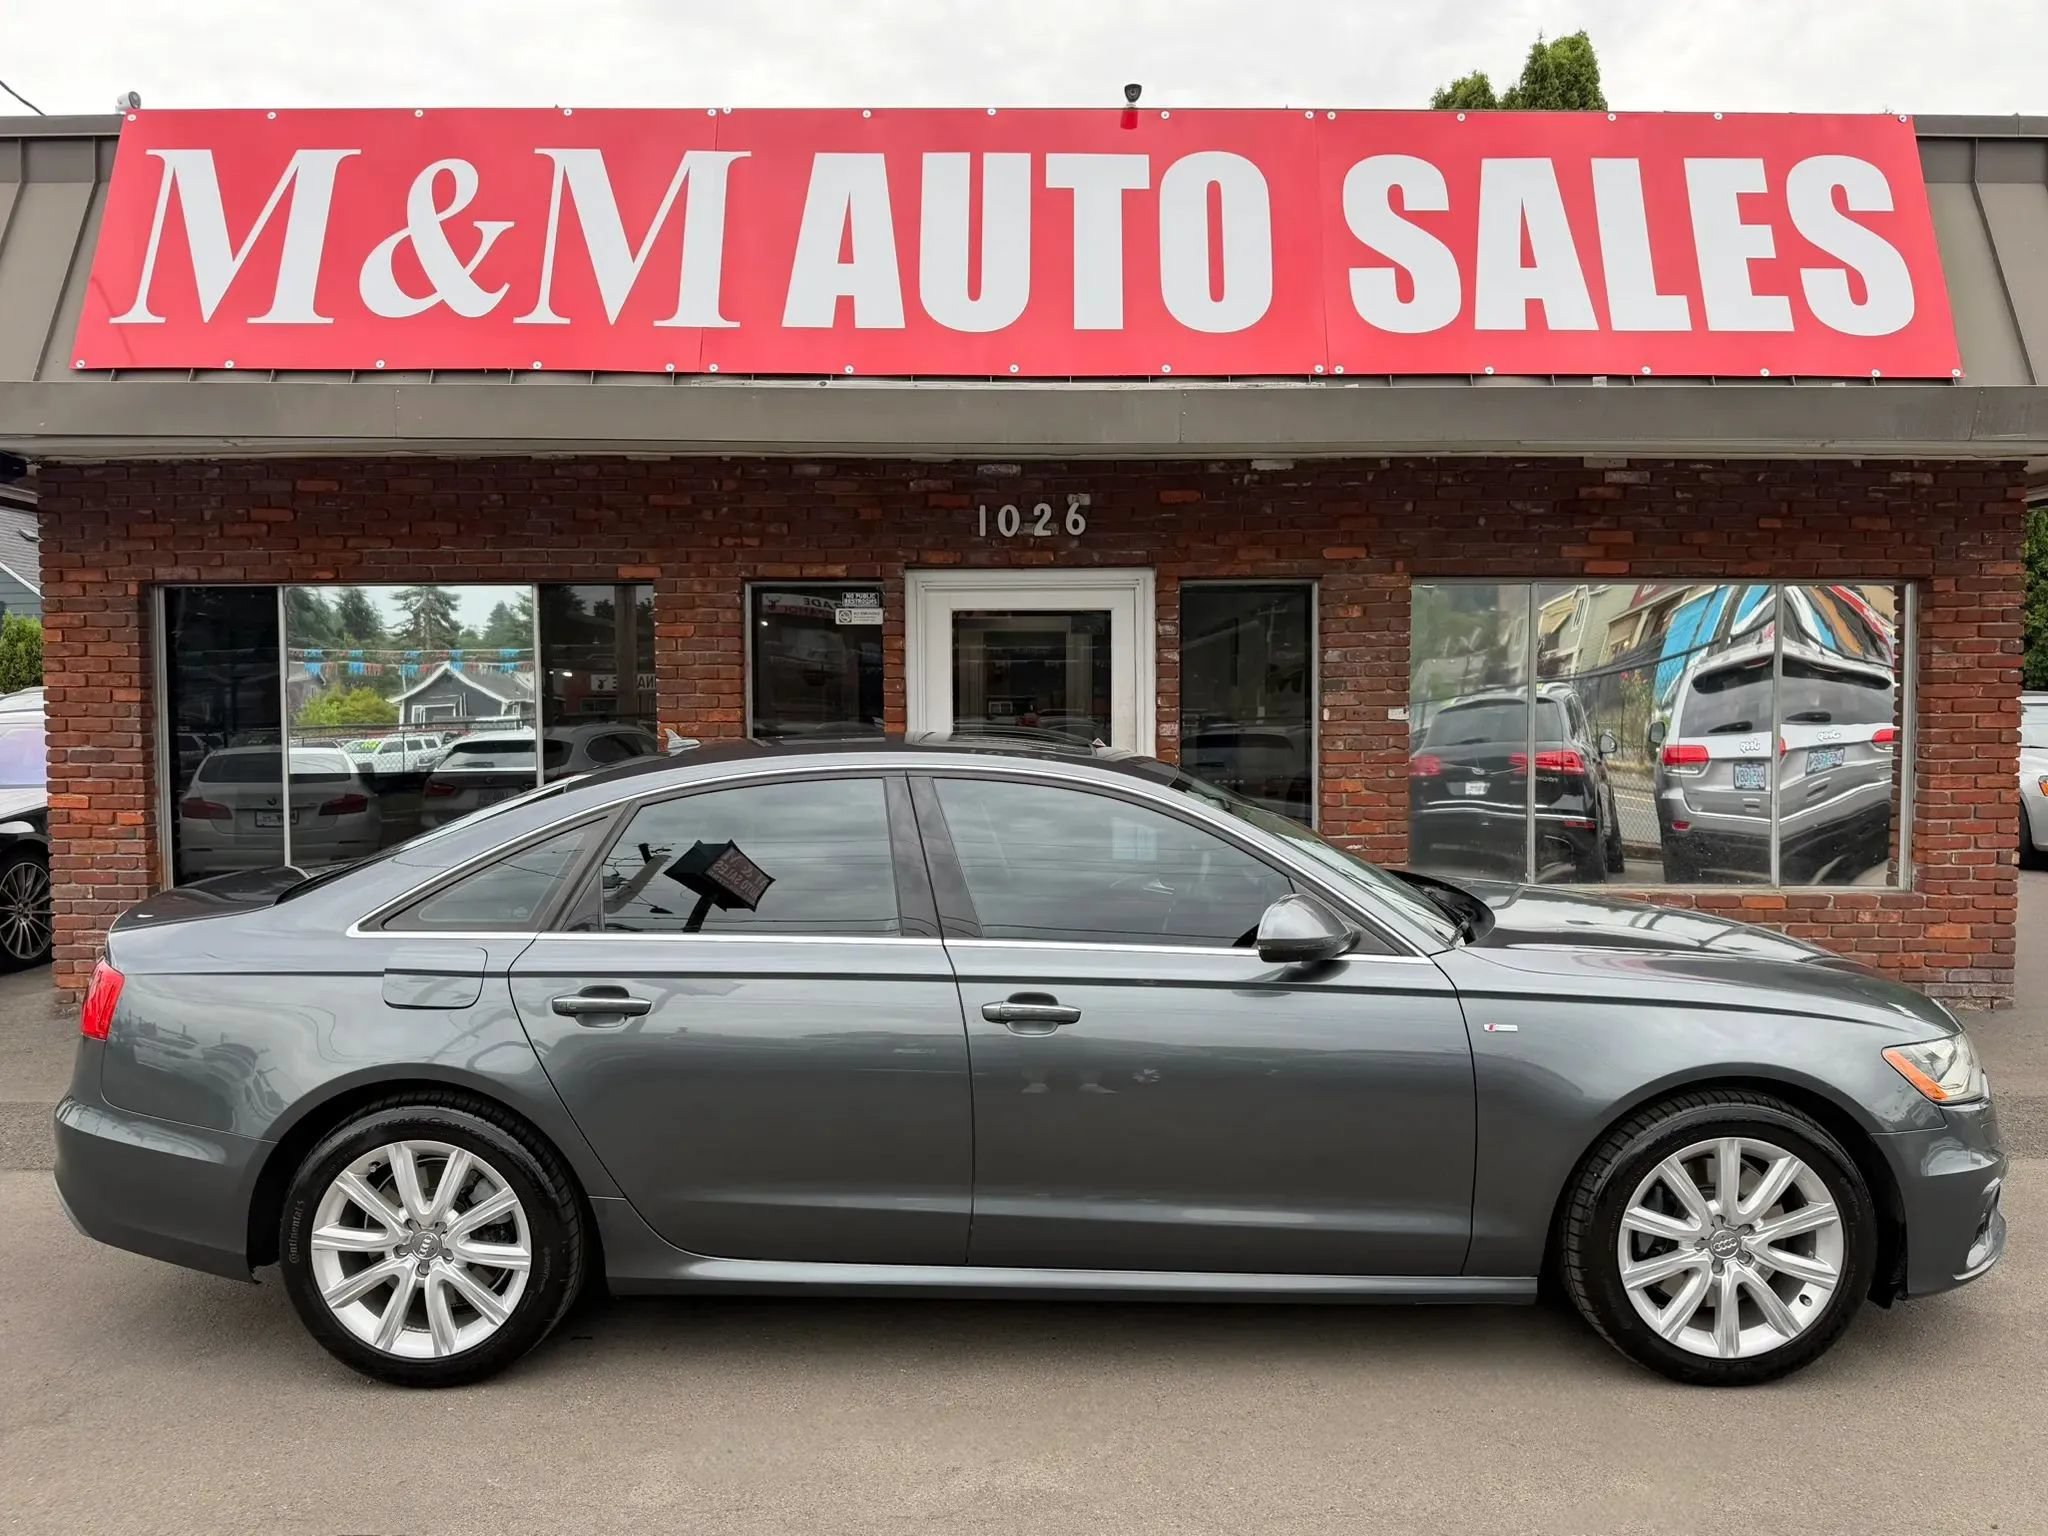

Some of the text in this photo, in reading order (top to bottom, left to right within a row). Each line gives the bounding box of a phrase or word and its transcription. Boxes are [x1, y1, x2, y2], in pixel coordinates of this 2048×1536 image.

[110, 149, 1914, 337] M&M AUTO SALES
[979, 502, 1086, 537] 1026
